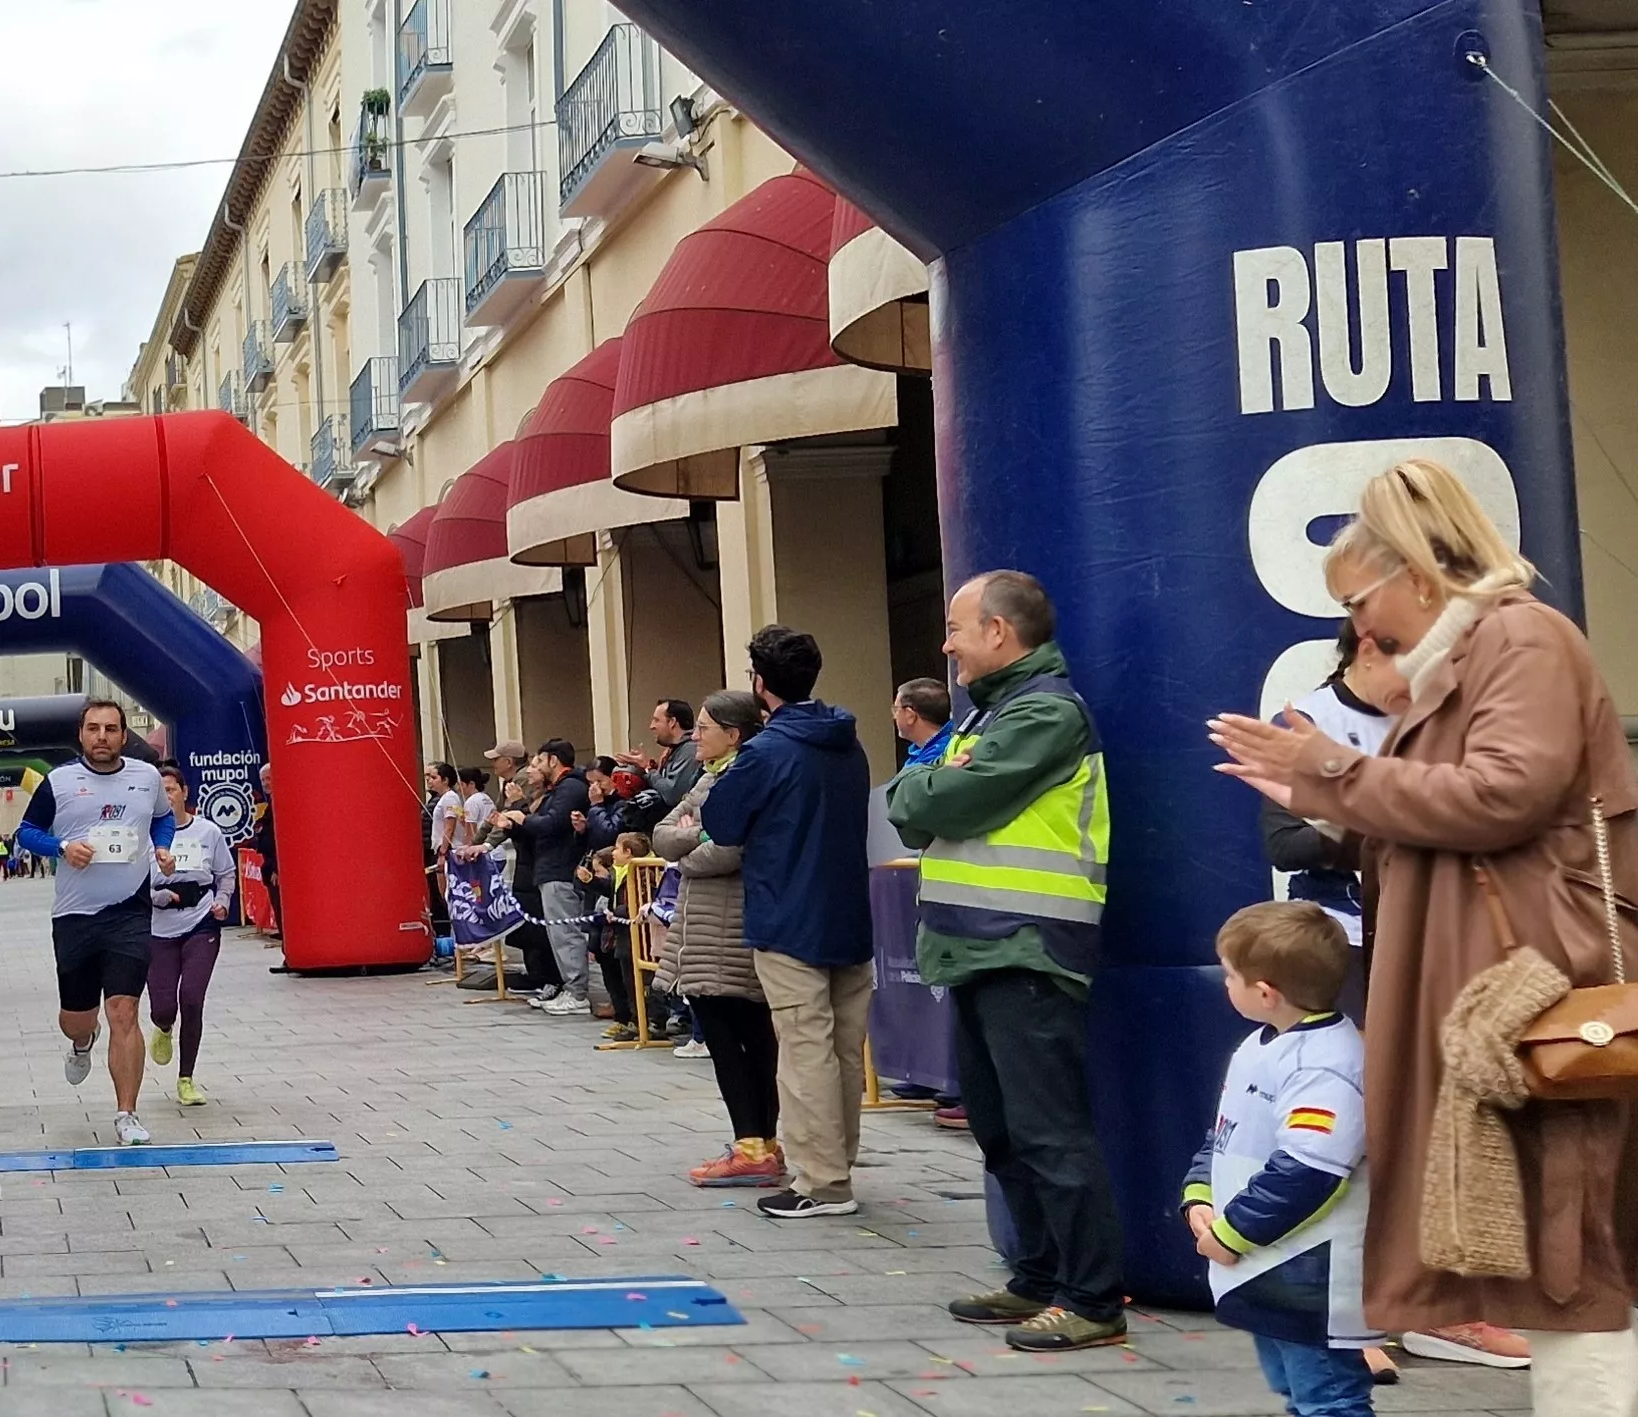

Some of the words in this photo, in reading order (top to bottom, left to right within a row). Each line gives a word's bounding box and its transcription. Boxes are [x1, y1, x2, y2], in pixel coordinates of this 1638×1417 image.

[1233, 236, 1513, 416] RUTA
[307, 647, 375, 671] Sports
[304, 680, 402, 704] Santander
[188, 749, 261, 767] fundación
[201, 765, 249, 783] mupol
[109, 844, 122, 854] 63
